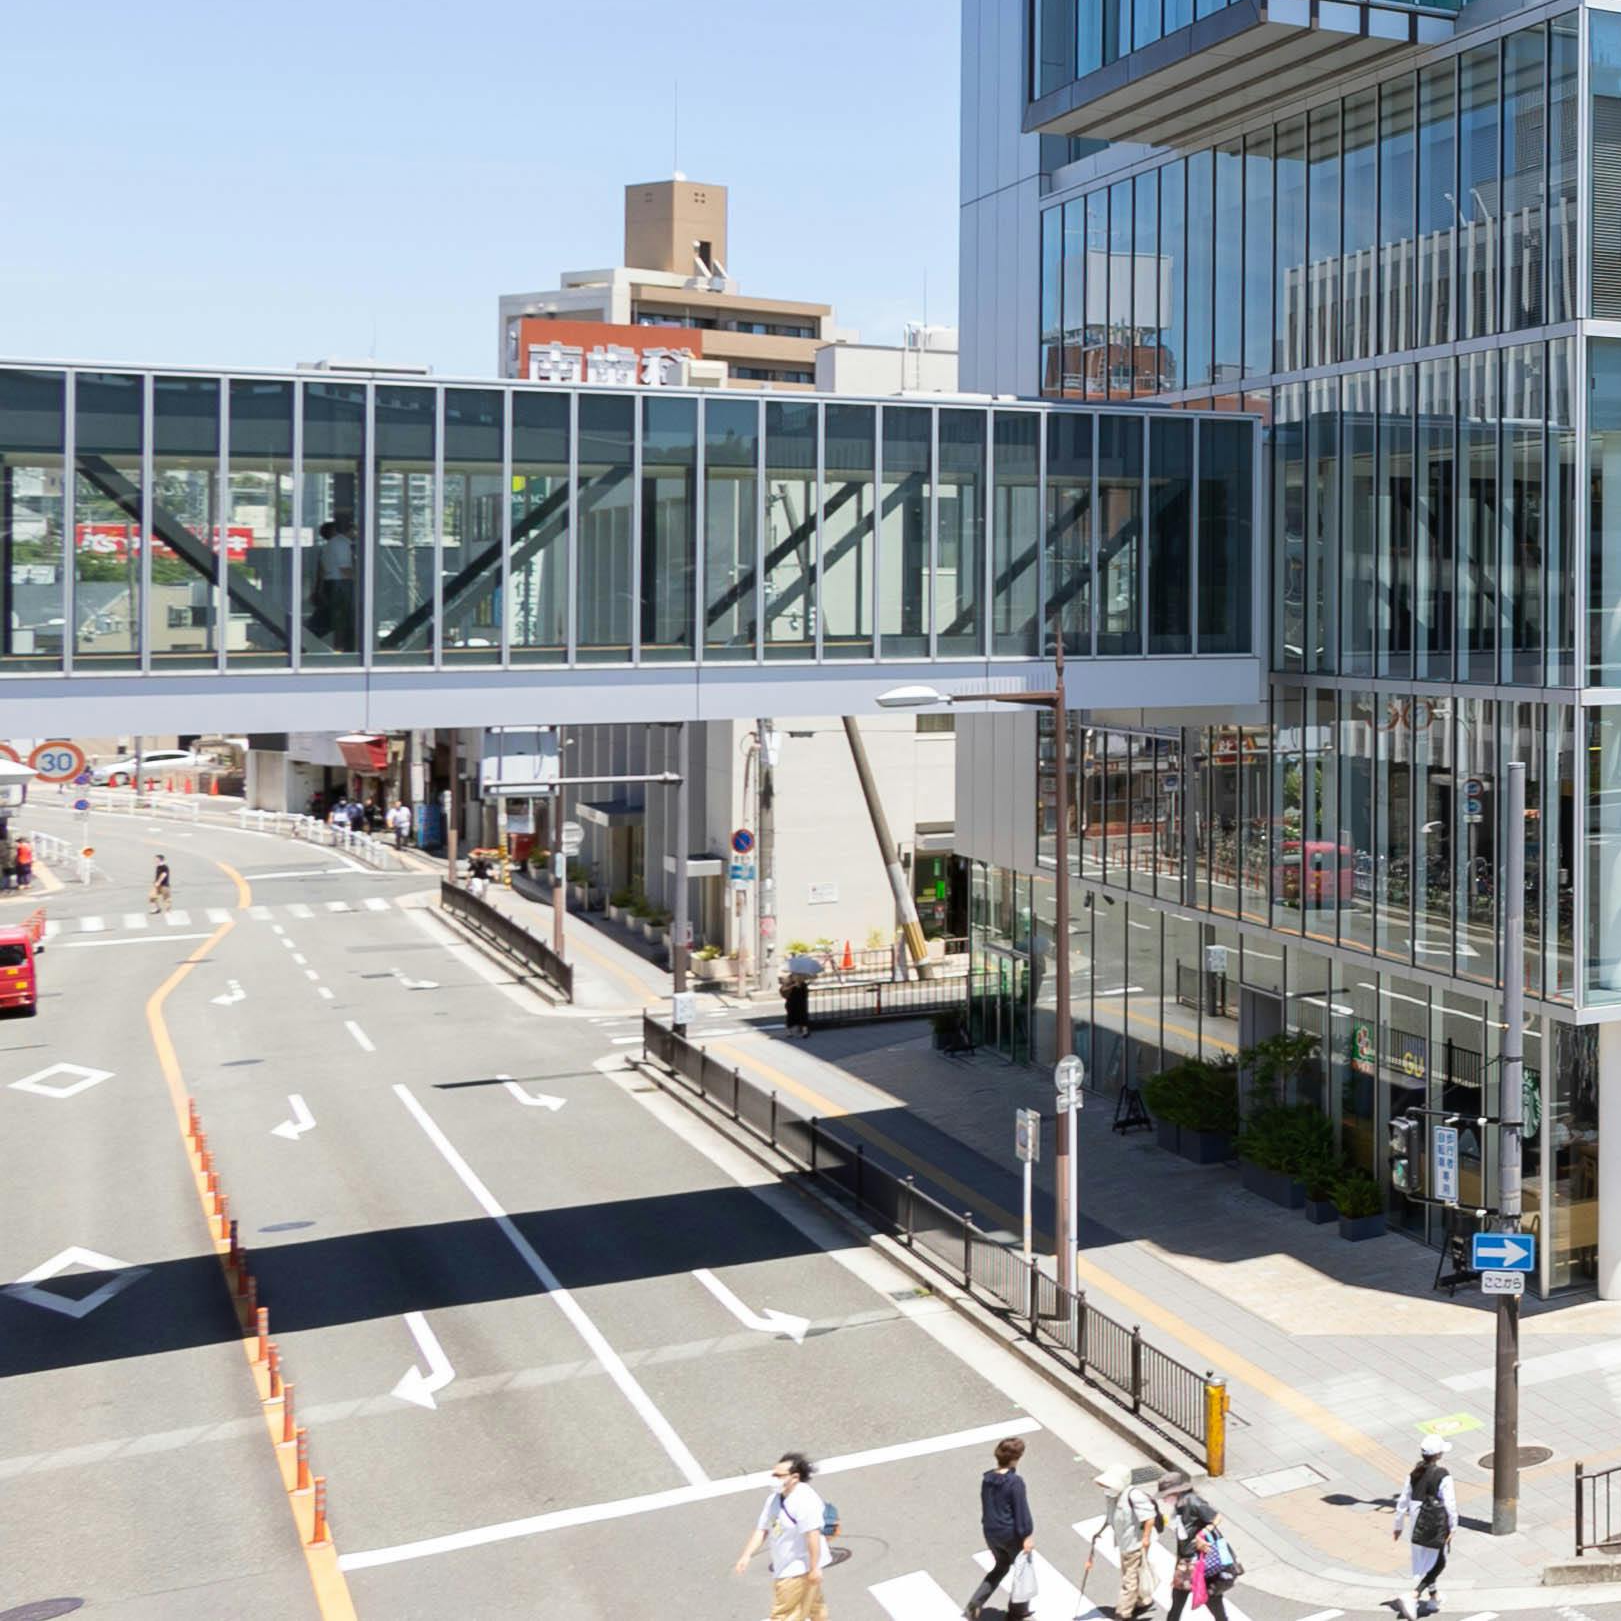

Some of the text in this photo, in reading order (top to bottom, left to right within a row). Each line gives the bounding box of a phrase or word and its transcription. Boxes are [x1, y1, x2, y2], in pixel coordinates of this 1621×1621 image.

[41, 752, 73, 773] 30
[1484, 1276, 1522, 1290] ここから
